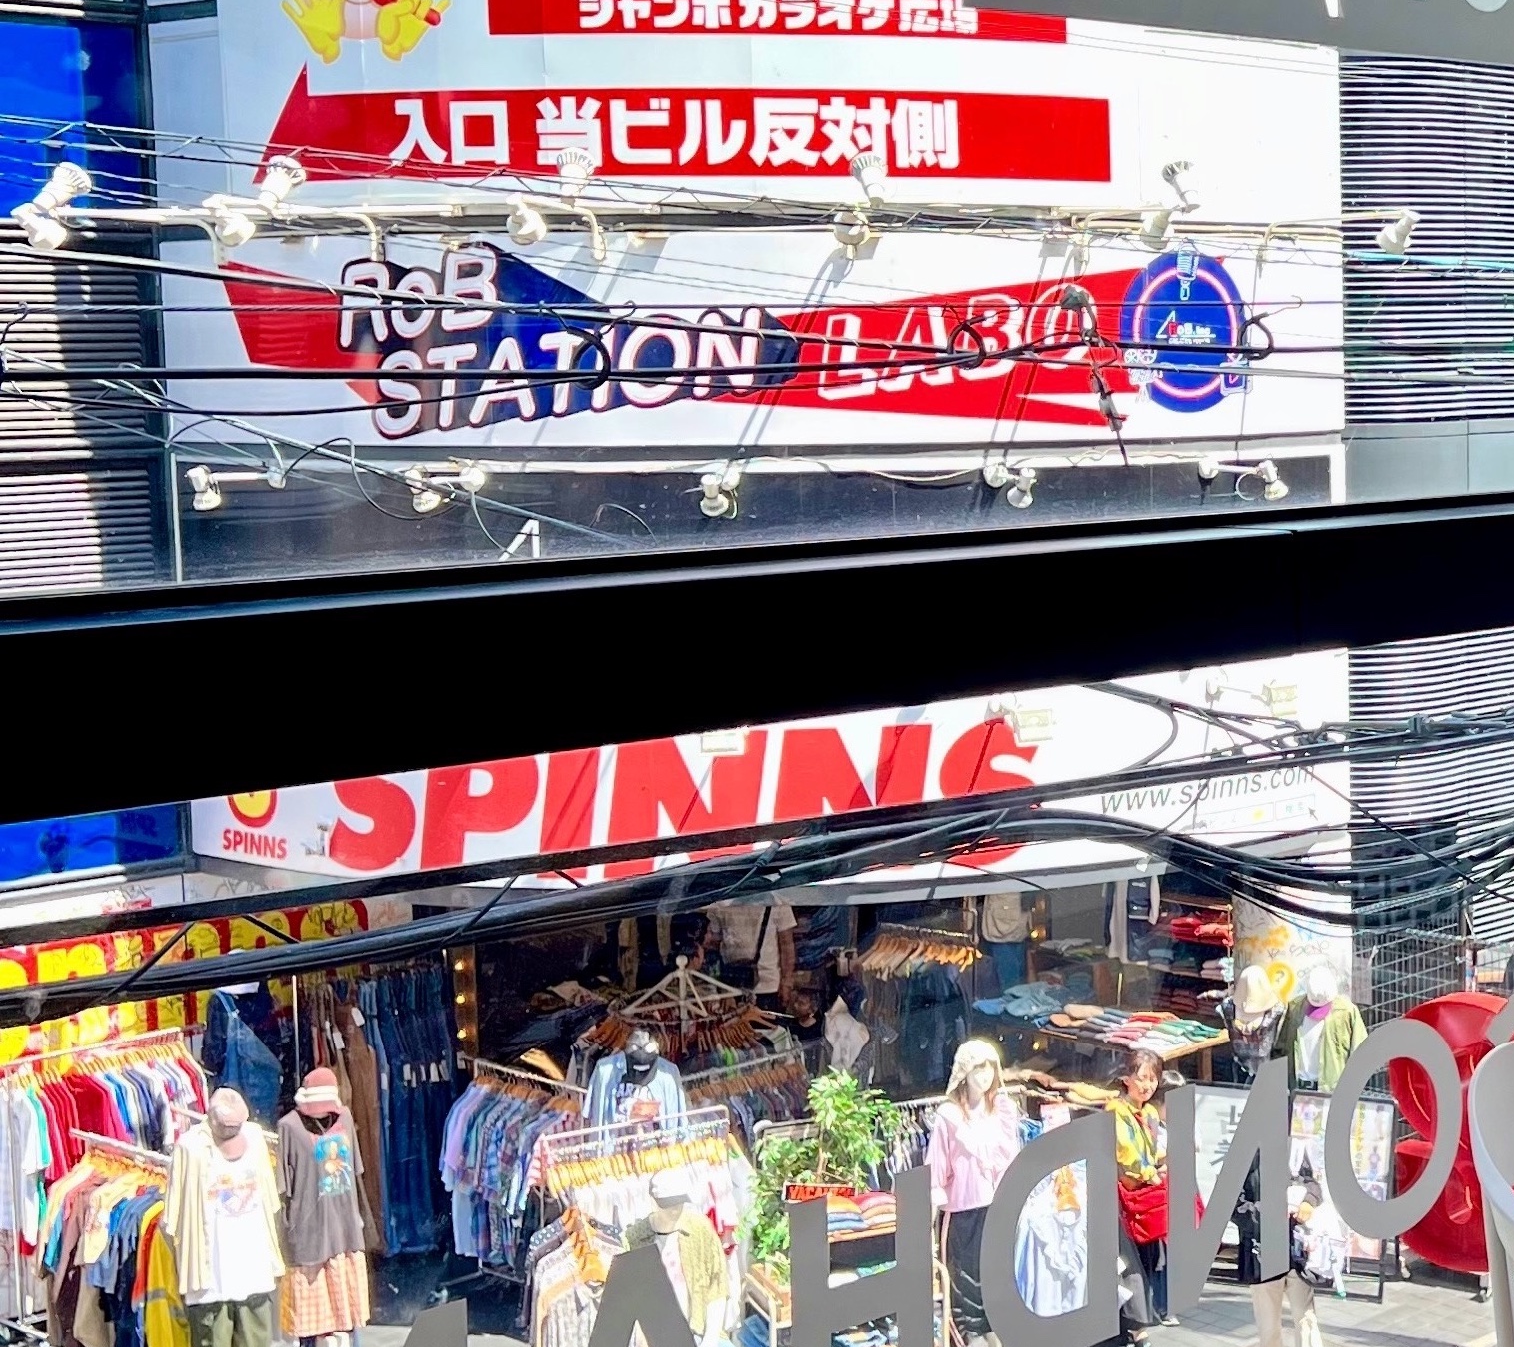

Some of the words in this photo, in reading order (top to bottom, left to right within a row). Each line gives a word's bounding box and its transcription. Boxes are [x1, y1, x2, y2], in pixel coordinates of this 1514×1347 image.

[389, 98, 511, 167] 入口
[535, 96, 959, 169] 当ビル反対側
[375, 306, 764, 439] STATION
[222, 828, 288, 860] SPINNS
[329, 717, 1041, 879] SPINNS
